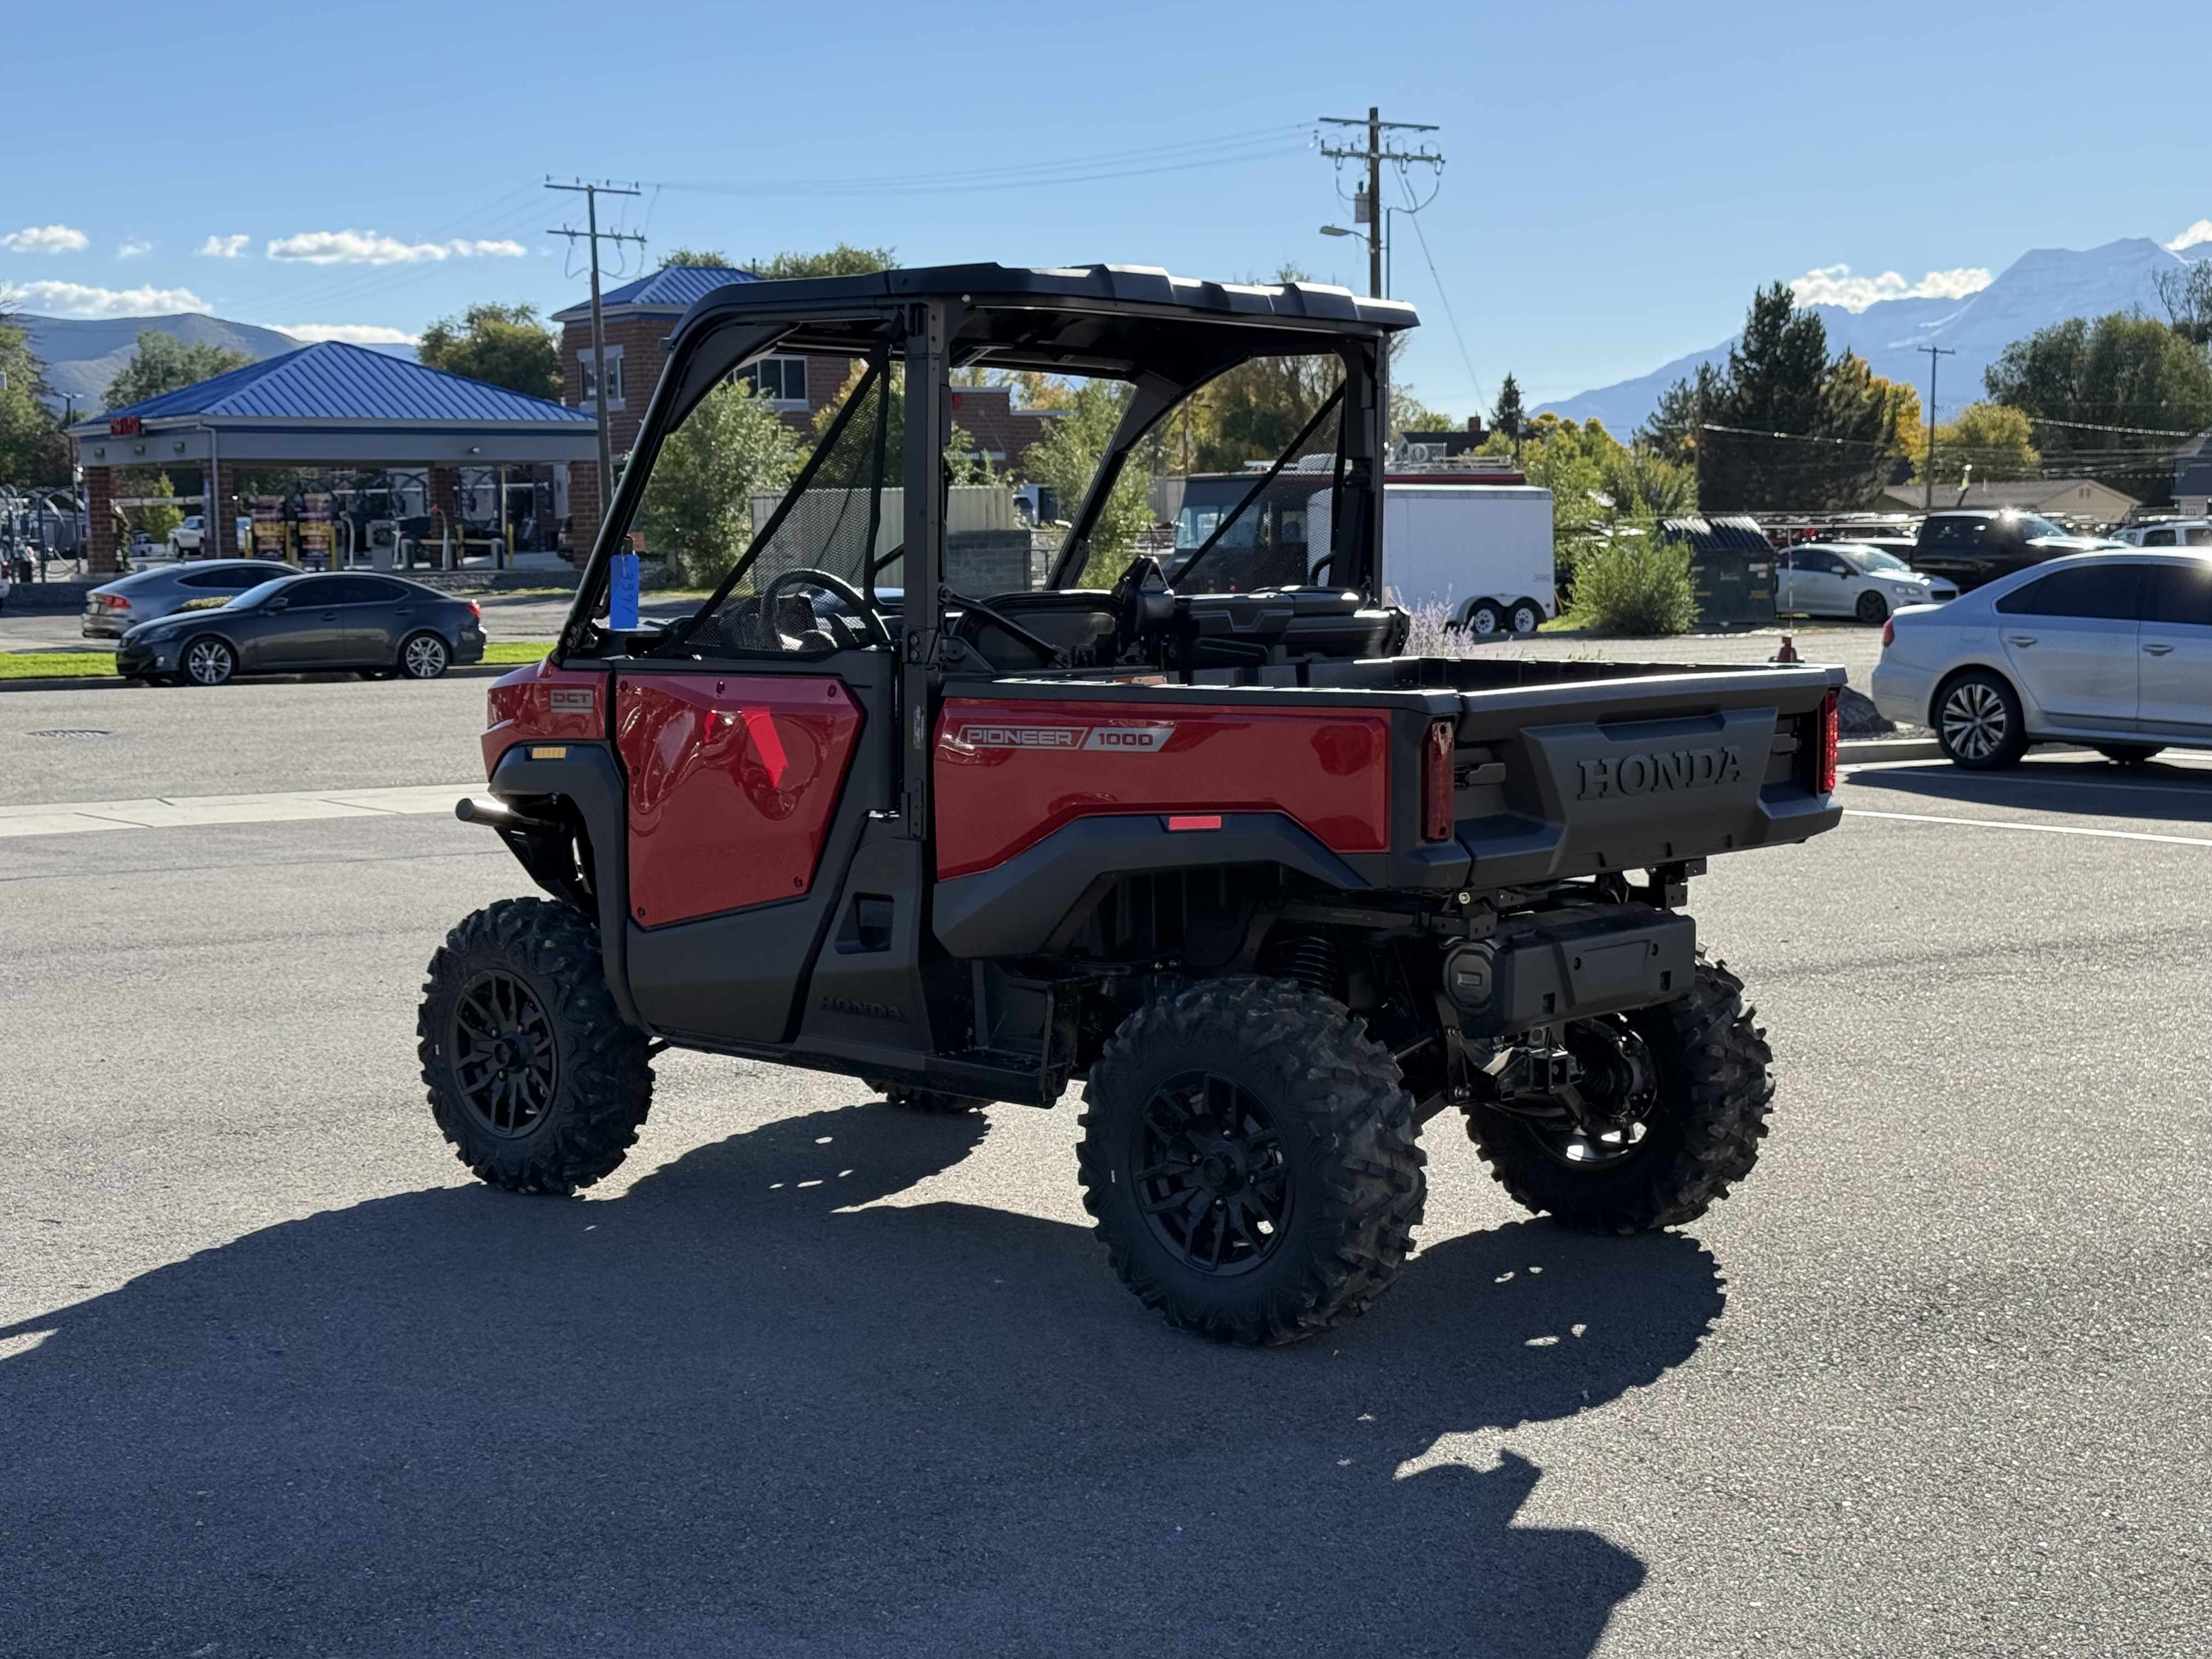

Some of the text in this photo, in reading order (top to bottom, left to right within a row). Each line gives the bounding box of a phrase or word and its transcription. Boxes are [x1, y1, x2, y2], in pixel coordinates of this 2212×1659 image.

[553, 693, 590, 703] DCT
[967, 729, 1153, 746] PIONEER 1000
[1577, 746, 1746, 801] HONDA
[820, 995, 908, 1024] HONDA
